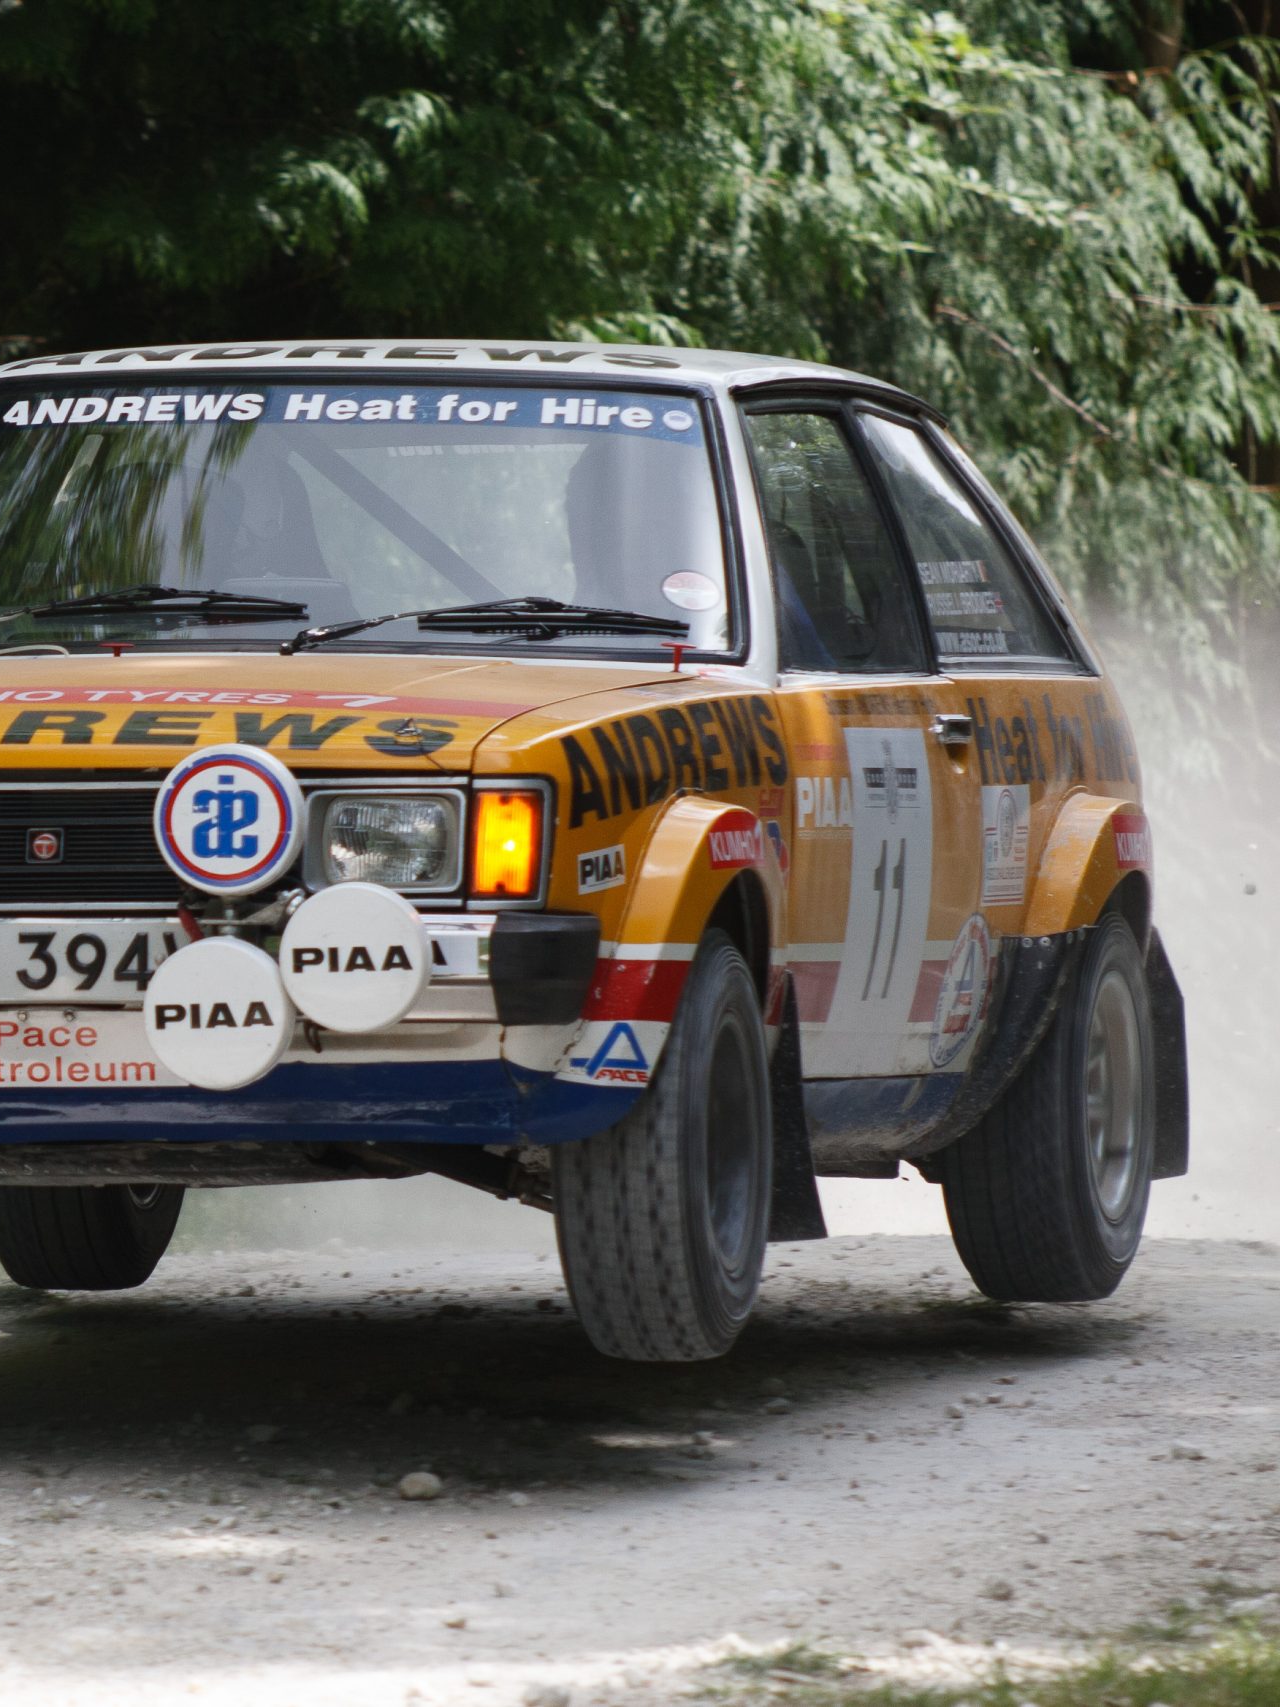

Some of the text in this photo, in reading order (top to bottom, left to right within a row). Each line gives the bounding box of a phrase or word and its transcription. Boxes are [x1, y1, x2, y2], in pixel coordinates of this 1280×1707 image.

[2, 393, 654, 429] ANDREWS Heat for Hire
[84, 690, 293, 705] TYRES
[966, 697, 1046, 785] Heat
[560, 694, 789, 830] ANDREWS
[796, 776, 854, 828] PIAA
[709, 829, 755, 862] KUMHO
[579, 850, 626, 886] PIAA
[862, 837, 906, 1001] 11
[16, 931, 180, 992] 394
[292, 945, 413, 974] PIAA
[154, 1001, 274, 1030] PIAA
[595, 1068, 650, 1083] PACE
